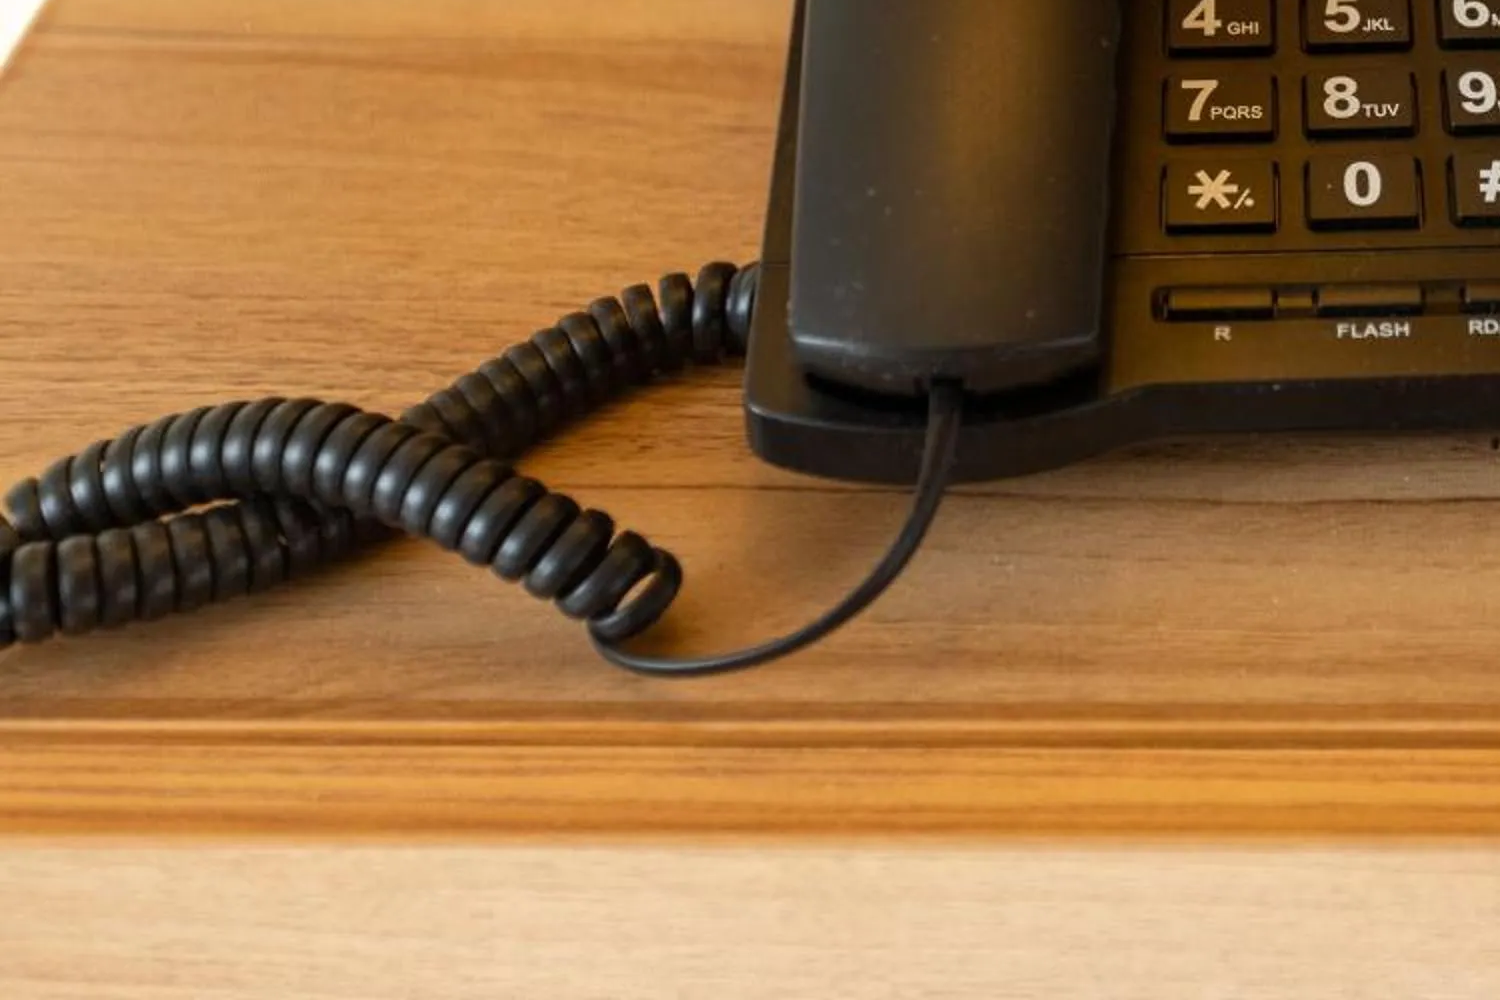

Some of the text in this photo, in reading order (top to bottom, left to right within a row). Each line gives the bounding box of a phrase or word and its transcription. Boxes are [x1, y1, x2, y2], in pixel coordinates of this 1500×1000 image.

[1226, 21, 1259, 36] GHI
[1361, 17, 1395, 32] JKL
[1181, 79, 1263, 121] 7 PQRS
[1323, 76, 1400, 119] 8 TUV
[1458, 71, 1497, 114] 9
[1343, 161, 1382, 207] 0
[1214, 326, 1231, 341] R
[1336, 322, 1410, 339] FLASH
